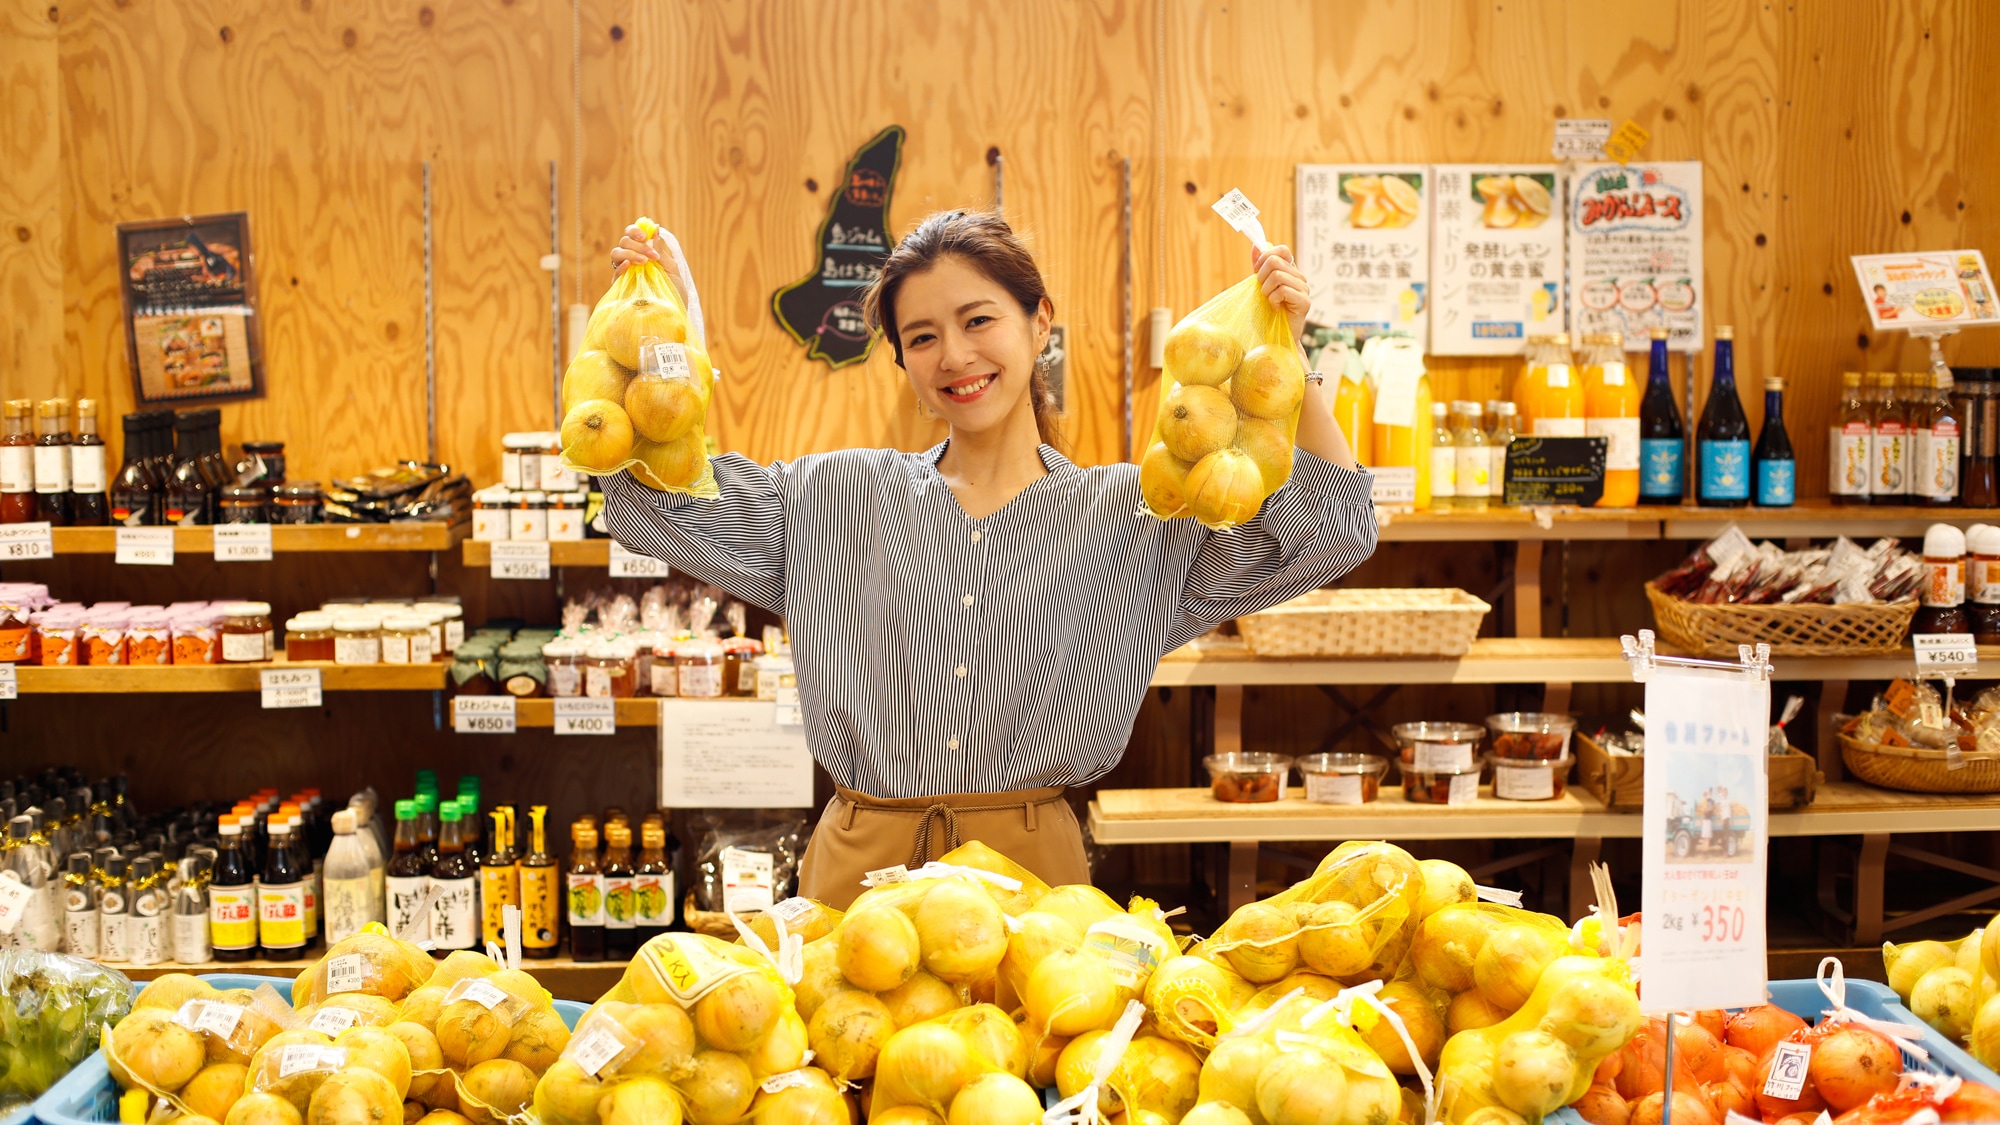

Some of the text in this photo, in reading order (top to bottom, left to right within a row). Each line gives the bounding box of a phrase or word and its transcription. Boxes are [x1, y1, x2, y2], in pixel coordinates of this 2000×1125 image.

[1331, 242, 1419, 260] 発酵レモン
[1464, 242, 1552, 260] 発酵レモン
[1336, 261, 1411, 278] の黄金蜜
[1470, 261, 1545, 278] の黄金蜜
[8, 542, 40, 556] ¥810
[622, 559, 657, 574] ¥650
[1927, 650, 1965, 663] ¥540
[458, 700, 512, 712] びわジャム
[467, 717, 504, 730] ¥650
[566, 717, 603, 731] ¥400
[1662, 912, 1684, 931] 2kg
